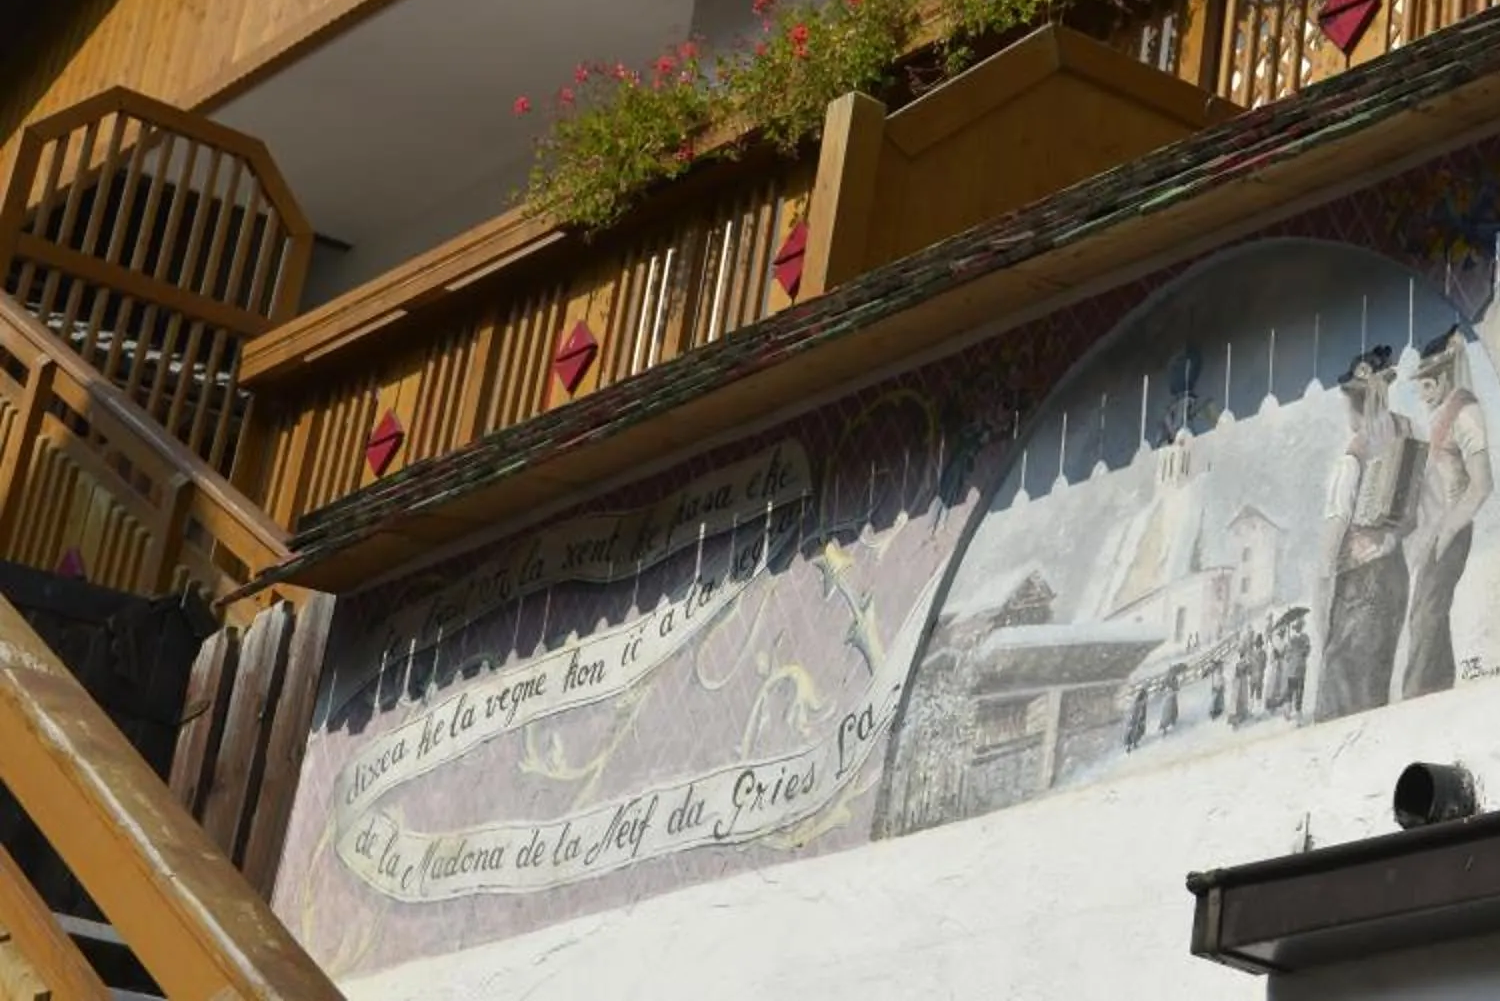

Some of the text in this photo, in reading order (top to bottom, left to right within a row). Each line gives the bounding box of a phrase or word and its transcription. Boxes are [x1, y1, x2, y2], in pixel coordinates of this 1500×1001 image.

[449, 692, 476, 738] la
[515, 827, 547, 869] de
[552, 820, 582, 867] la
[667, 783, 706, 835] da
